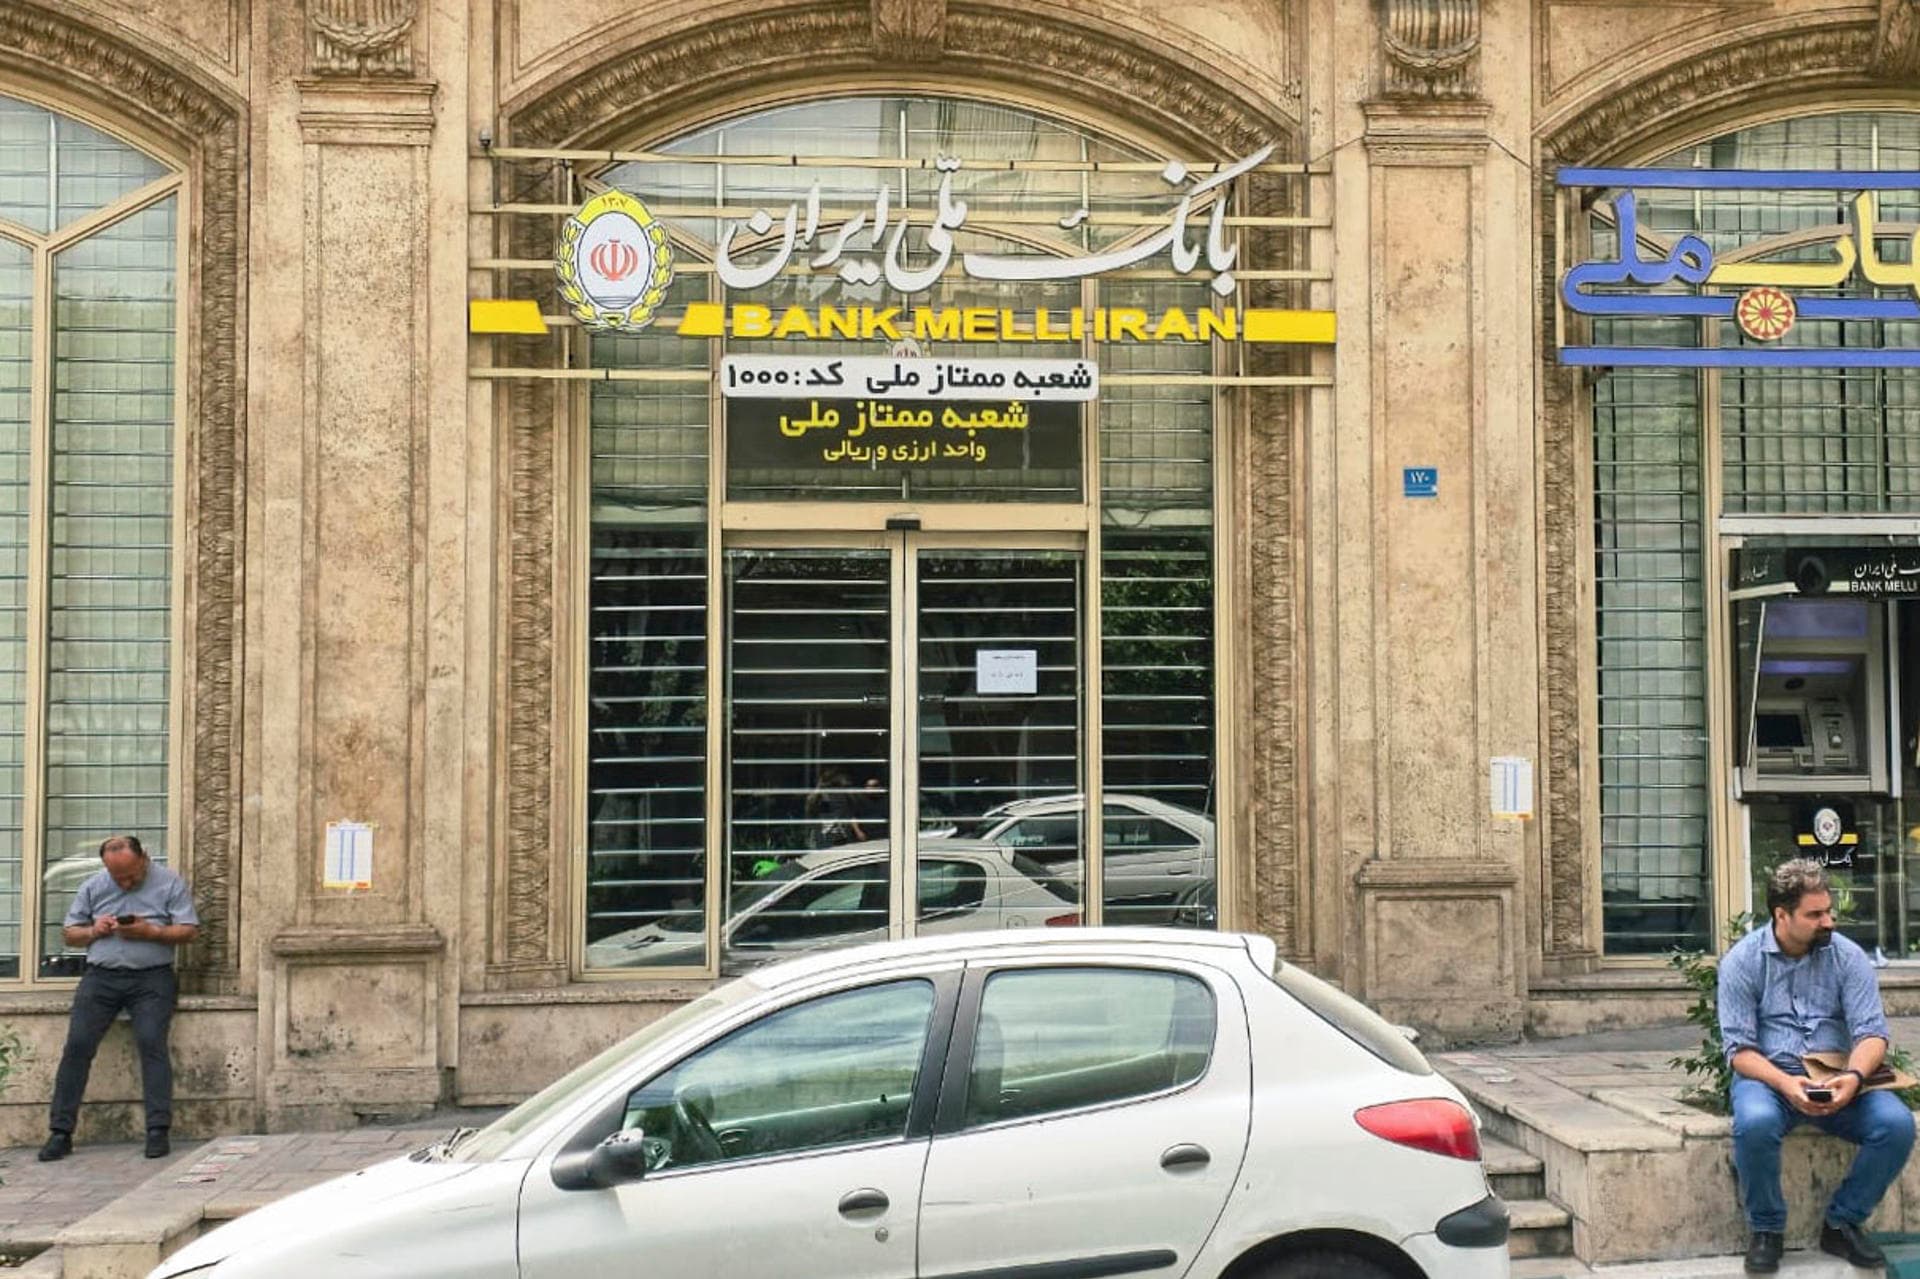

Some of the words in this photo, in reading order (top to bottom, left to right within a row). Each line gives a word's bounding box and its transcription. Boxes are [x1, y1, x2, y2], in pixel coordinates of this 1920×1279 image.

[716, 177, 891, 290] ایران
[732, 304, 903, 340] BANK
[914, 307, 1085, 342] MELLI
[1094, 307, 1236, 342] IRAN
[866, 363, 921, 394] ملی
[927, 364, 1006, 396] ممتاز
[1013, 363, 1092, 397] شعبه
[779, 400, 840, 437] ملی
[848, 401, 934, 437] ممتاز
[941, 400, 1029, 438] شعبه
[891, 440, 936, 462] ارزی
[943, 440, 987, 462] واحد
[1851, 580, 1882, 592] BANK
